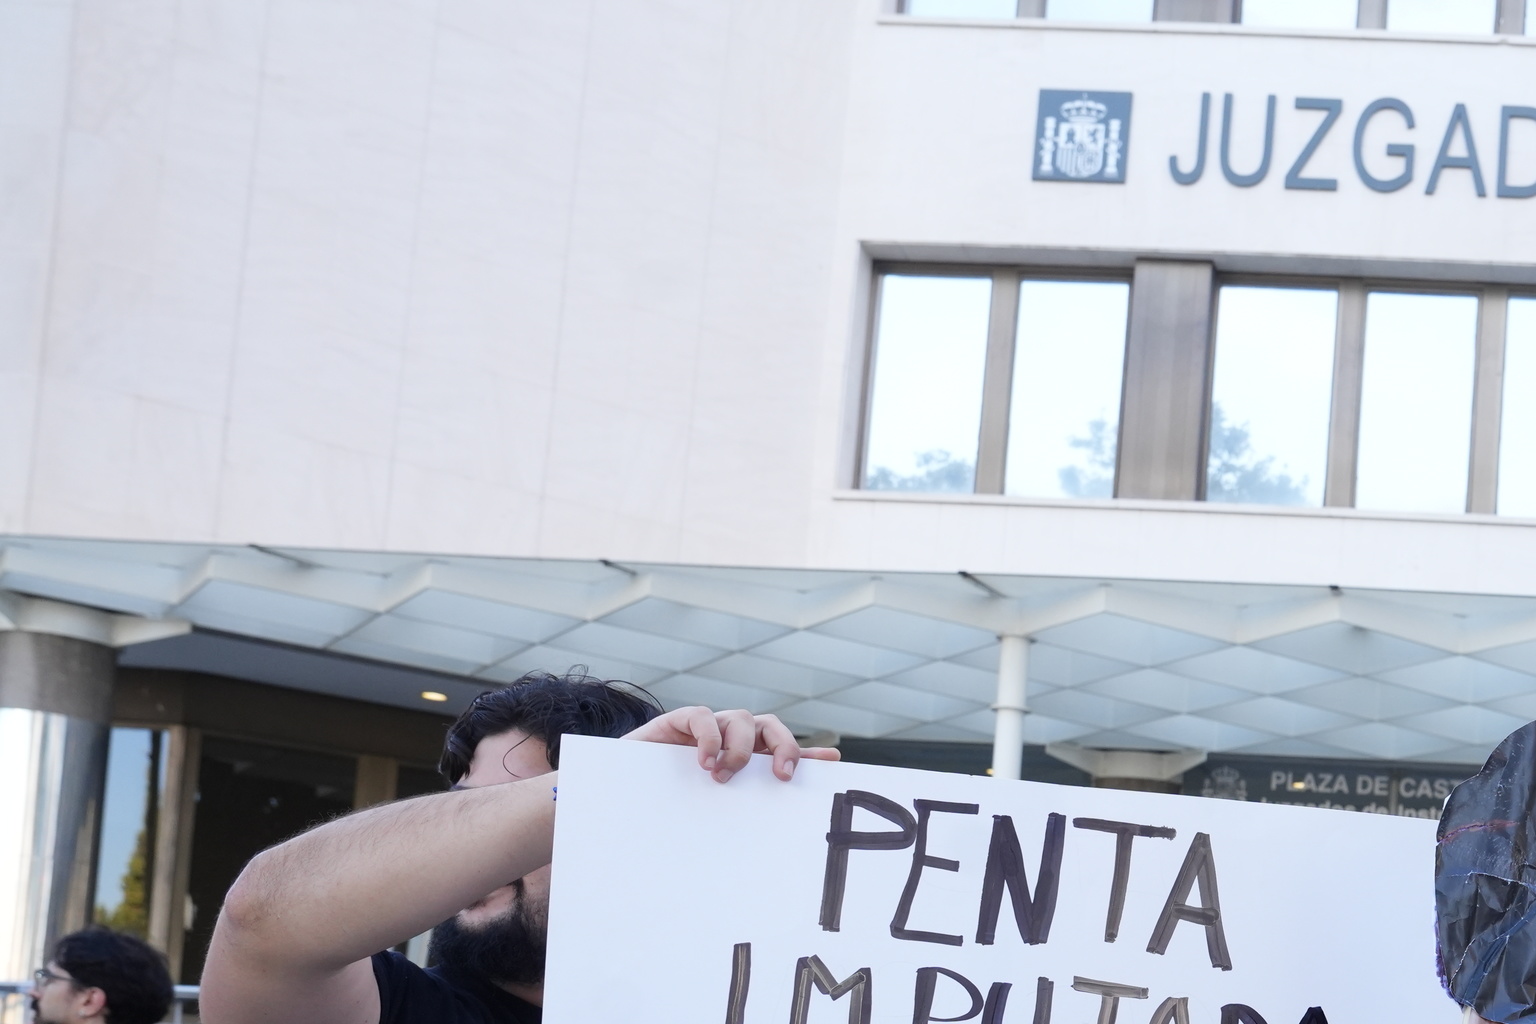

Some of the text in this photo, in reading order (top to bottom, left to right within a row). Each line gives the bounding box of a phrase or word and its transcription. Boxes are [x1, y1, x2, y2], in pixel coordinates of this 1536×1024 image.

[1270, 771, 1349, 794] PLAZA
[1356, 775, 1389, 796] DE
[819, 789, 1232, 971] PENTA
